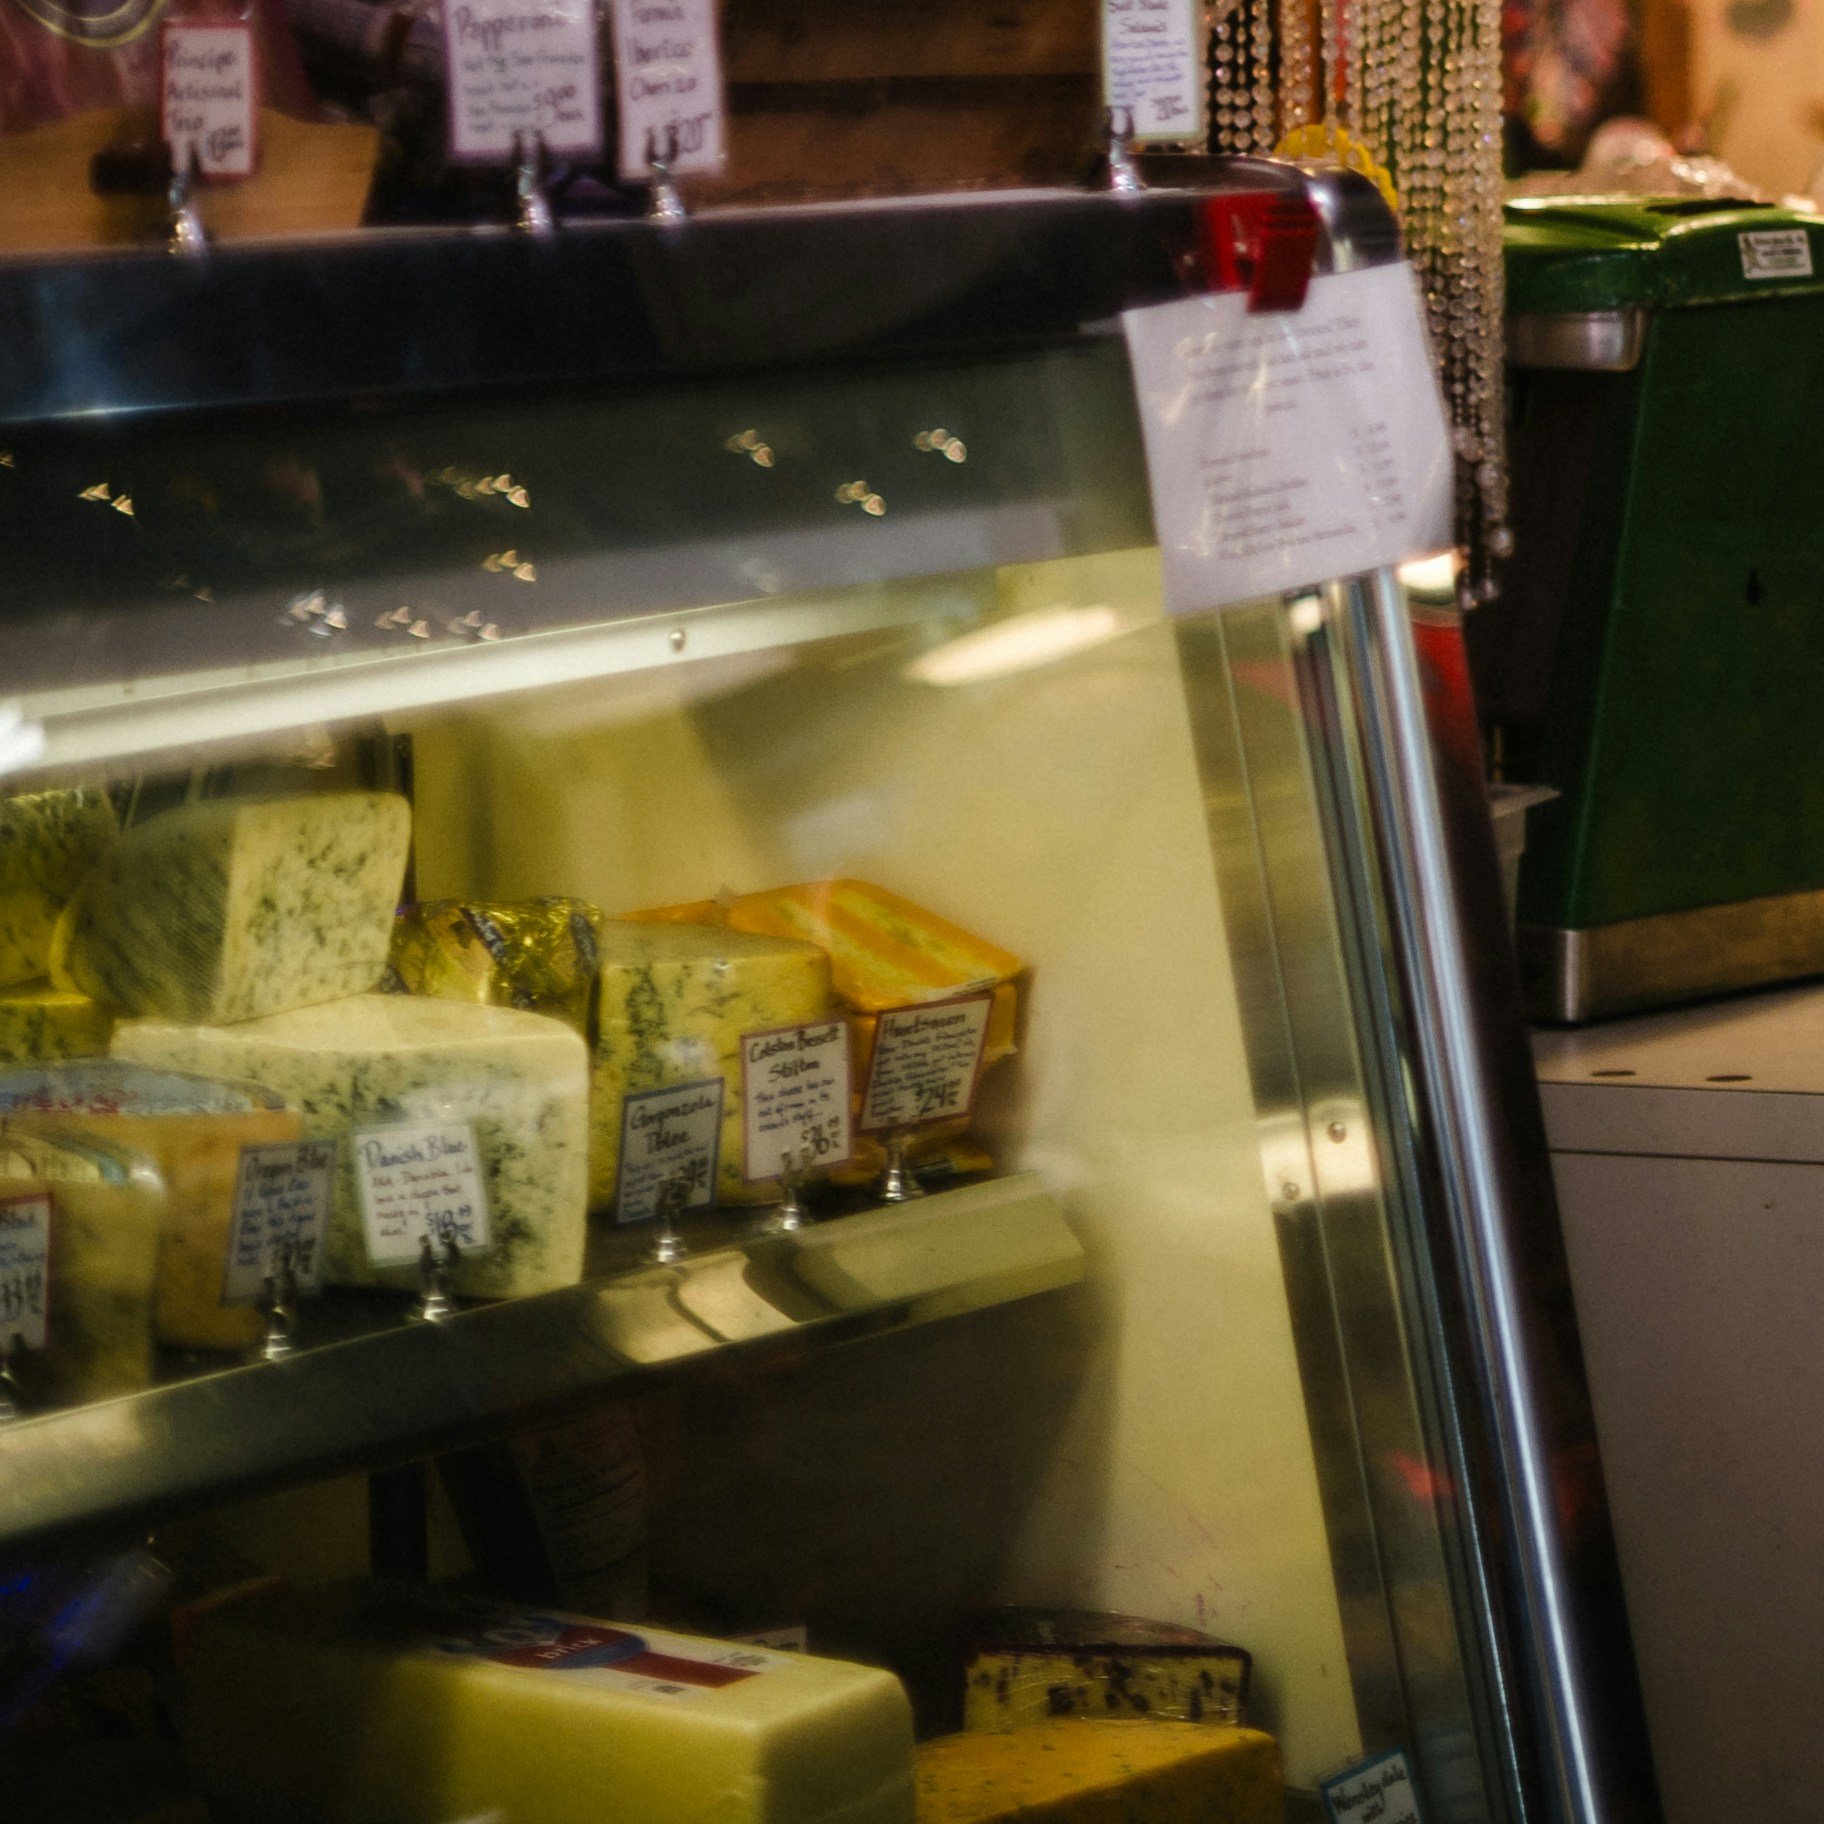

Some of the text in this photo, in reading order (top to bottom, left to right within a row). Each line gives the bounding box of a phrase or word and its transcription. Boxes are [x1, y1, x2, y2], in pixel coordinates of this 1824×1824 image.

[882, 1013, 967, 1041] Huntsman
[750, 1026, 841, 1063] Colston Bassett
[768, 1057, 821, 1083] Stilton
[363, 1134, 468, 1170] Danish Blue
[536, 1633, 605, 1662] brick
